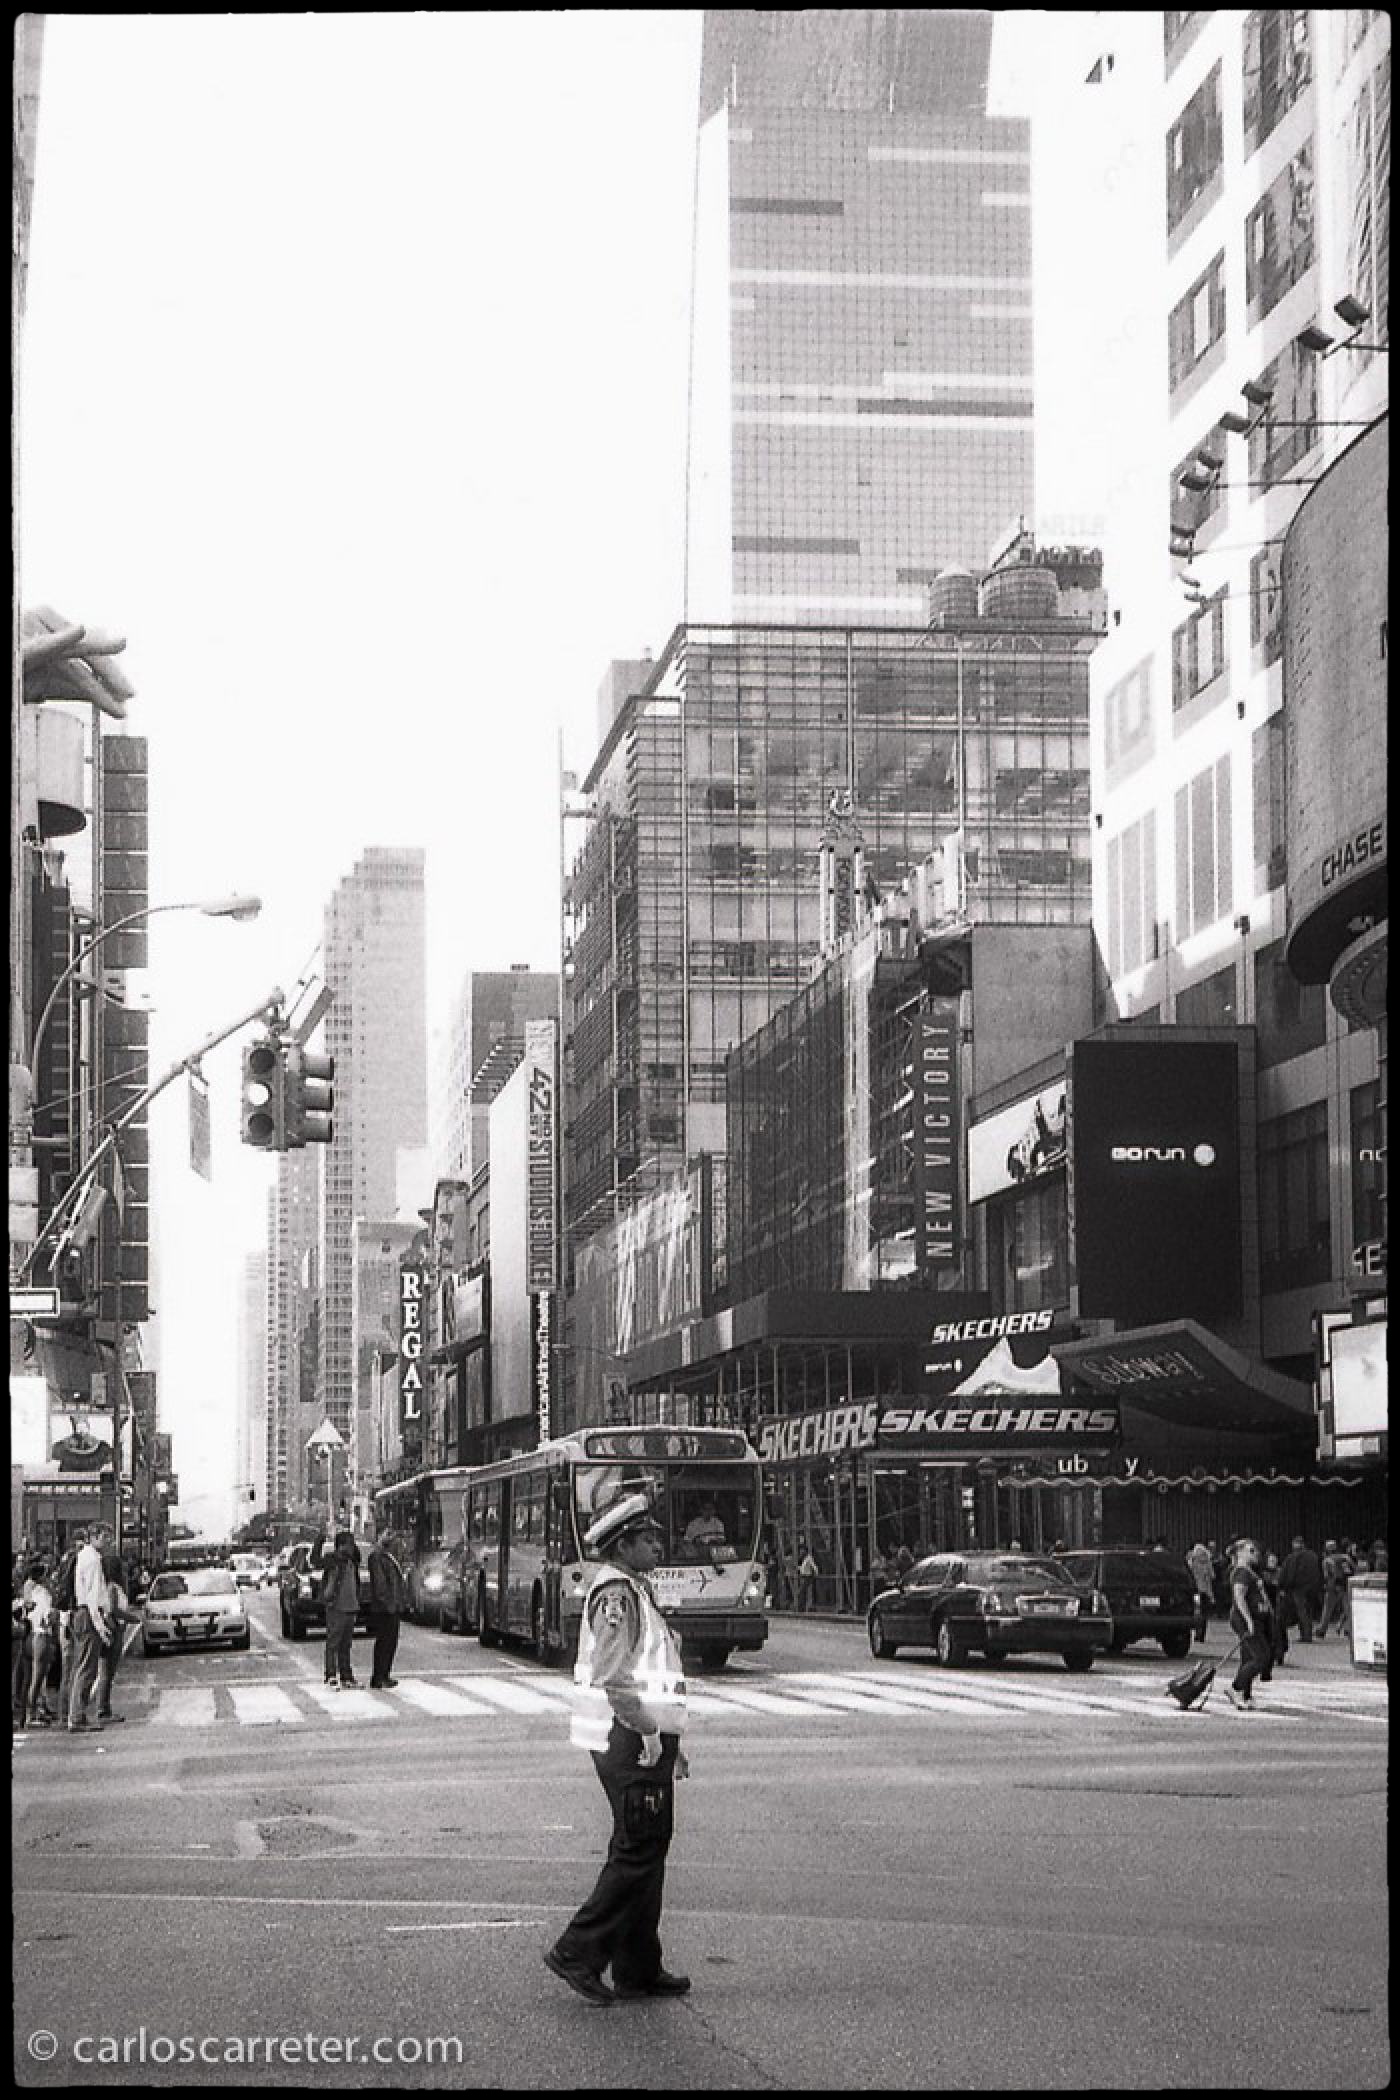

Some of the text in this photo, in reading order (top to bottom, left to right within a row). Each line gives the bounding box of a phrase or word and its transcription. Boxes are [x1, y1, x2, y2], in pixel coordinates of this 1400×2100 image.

[1321, 822, 1383, 887] CHASE
[529, 1066, 552, 1112] 42
[922, 1023, 953, 1257] NEW VICTORY
[529, 1139, 553, 1221] STUDIOS
[401, 1271, 423, 1420] REGAL
[931, 1309, 1054, 1344] SKECHERS
[758, 1401, 878, 1462] SKECHERS
[877, 1409, 1118, 1433] SKECHERS
